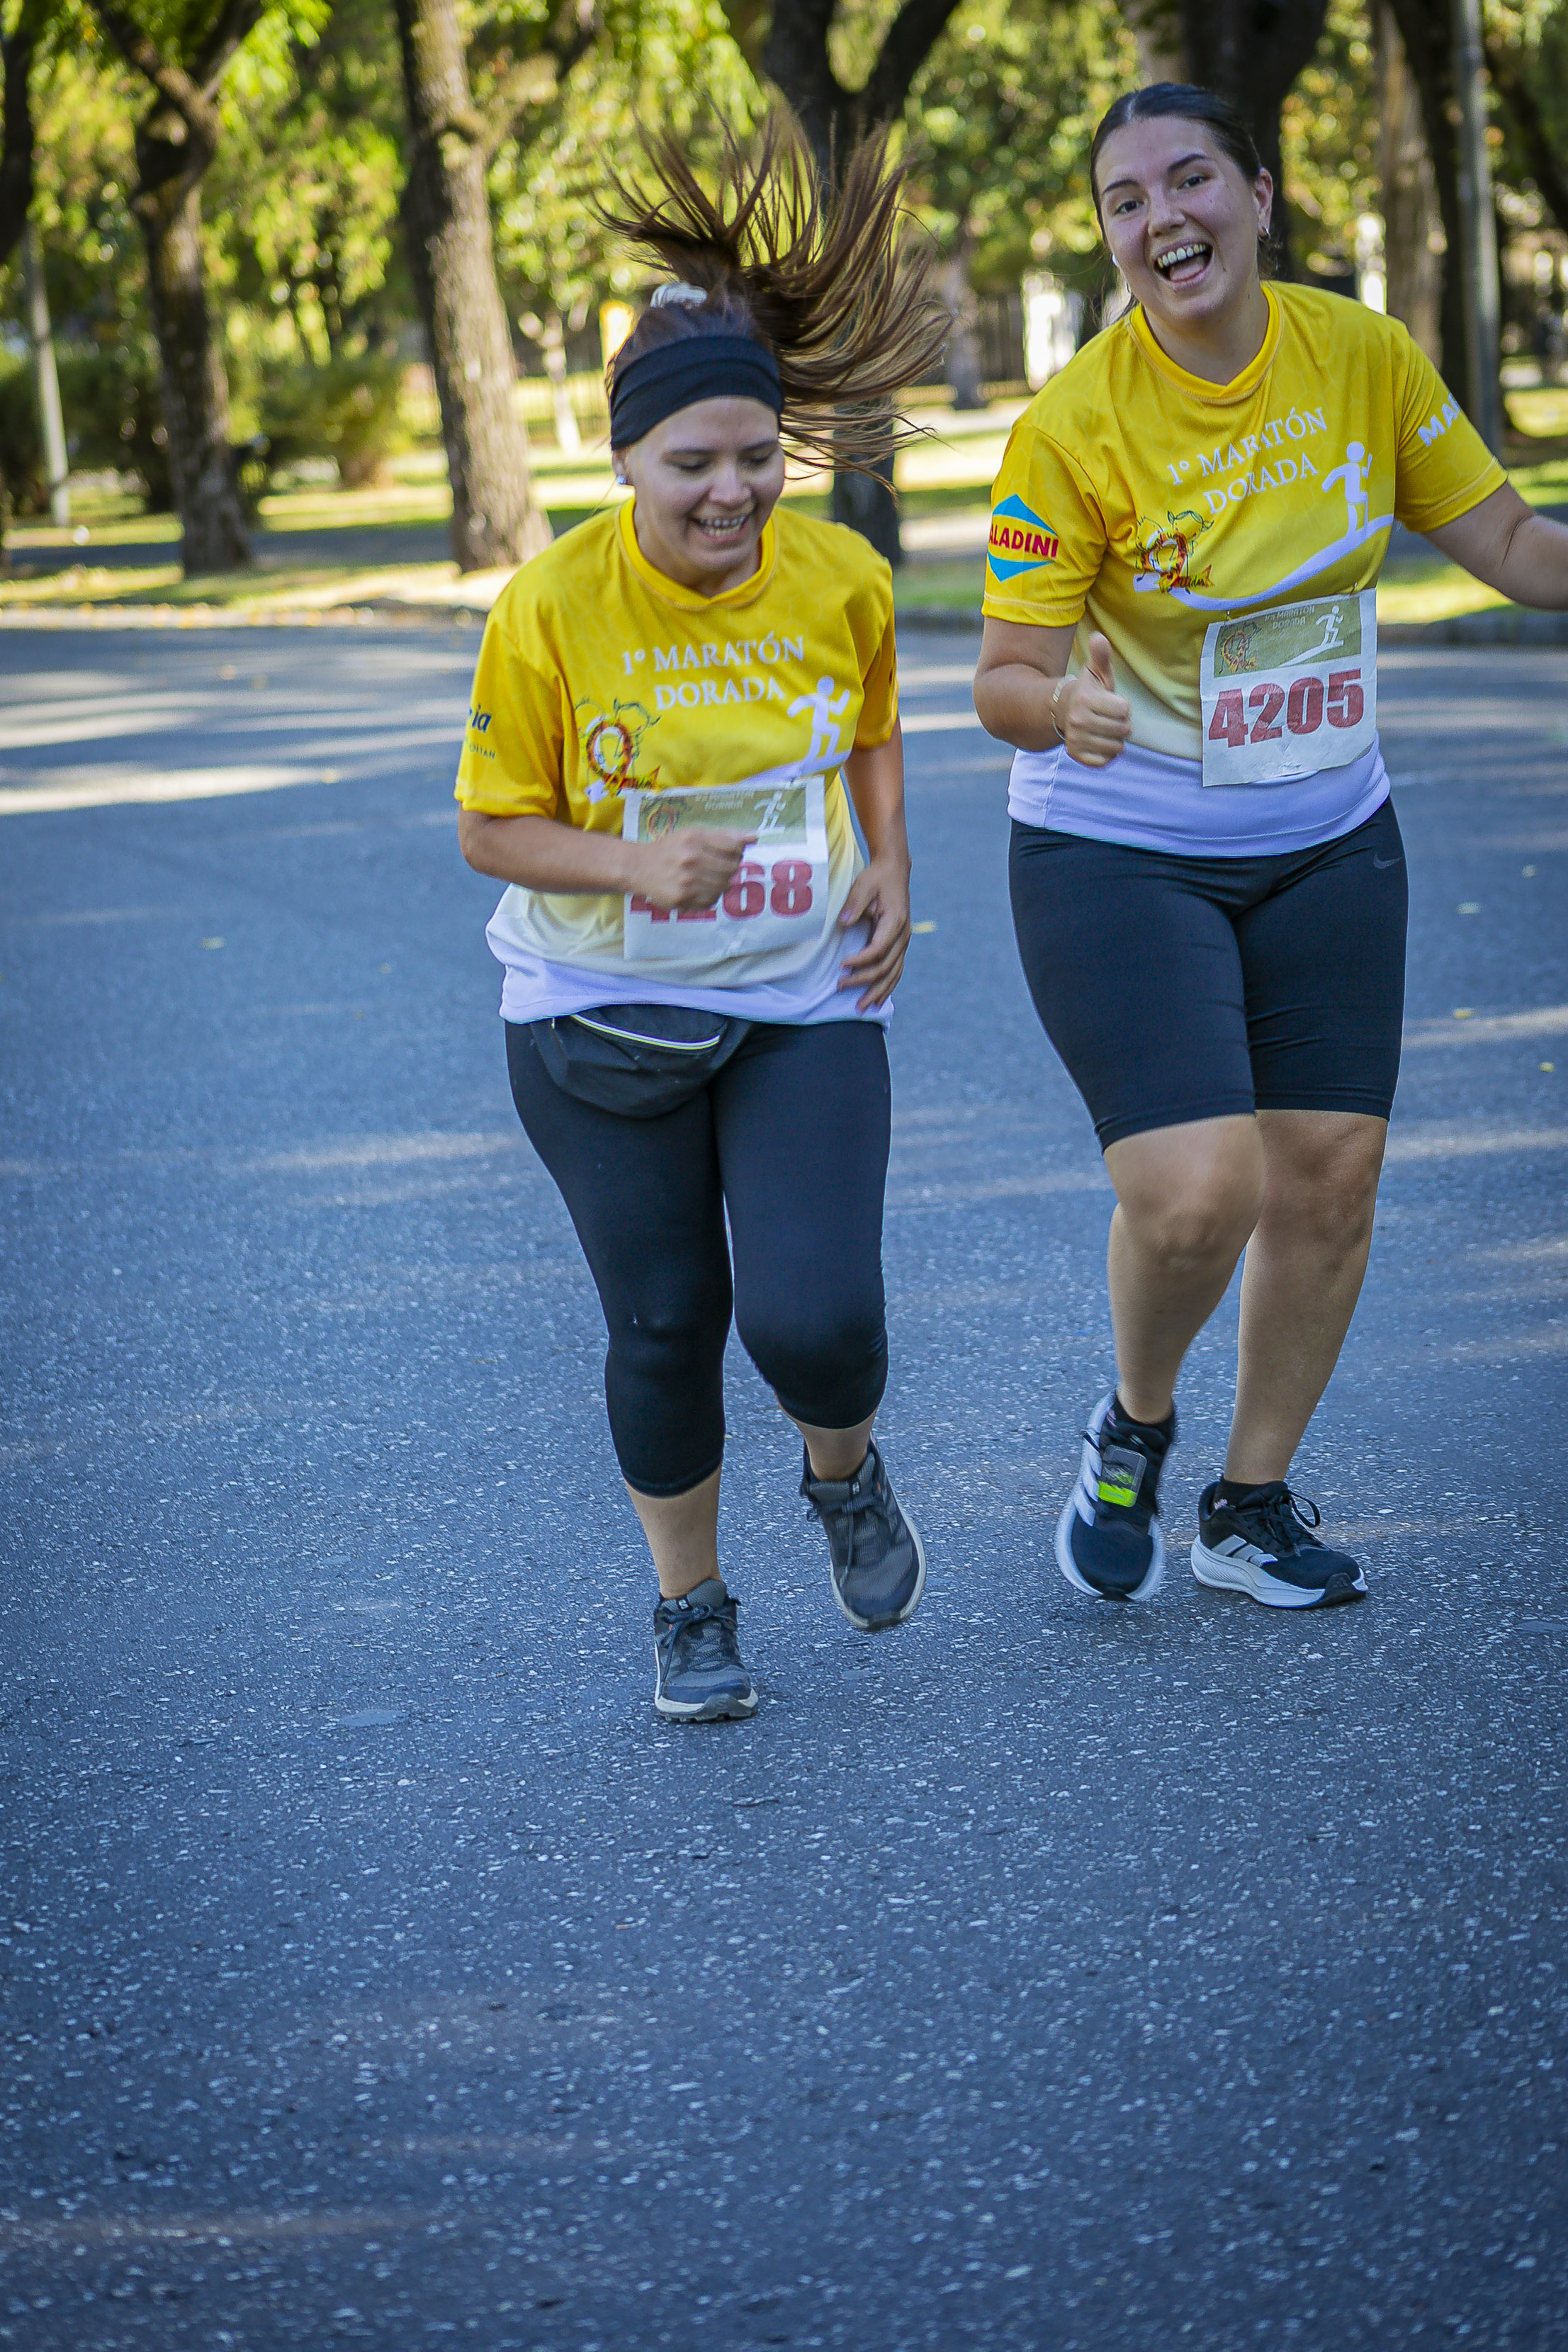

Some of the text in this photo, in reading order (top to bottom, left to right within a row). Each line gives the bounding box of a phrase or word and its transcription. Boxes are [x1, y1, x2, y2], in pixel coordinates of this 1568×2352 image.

[1196, 407, 1328, 477] MARATÓN
[1203, 453, 1319, 514] DORADA
[1272, 616, 1306, 630] DORADA
[653, 631, 804, 673] MARATÓN
[654, 675, 785, 711] DORADA
[1208, 668, 1365, 748] 4205
